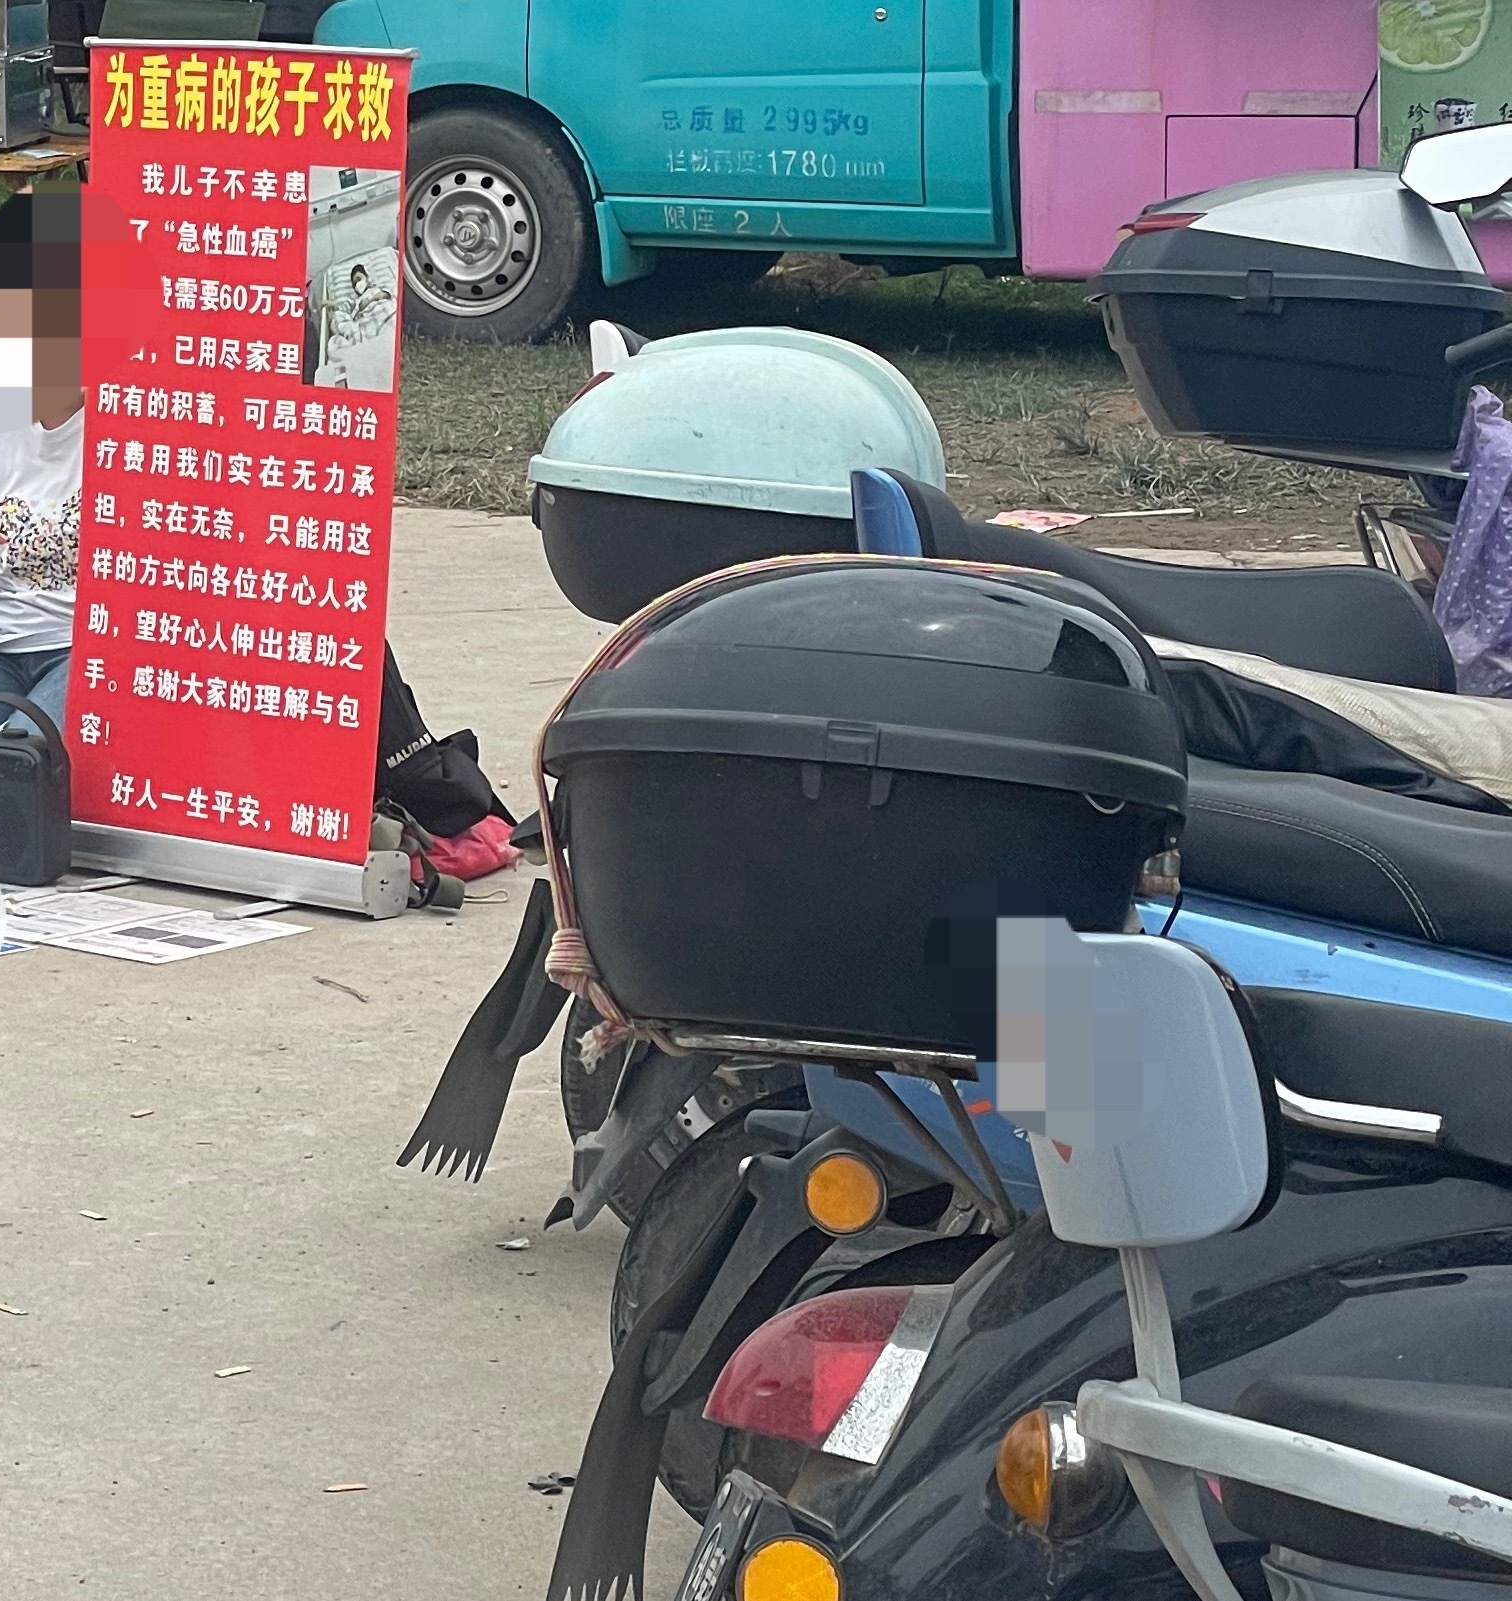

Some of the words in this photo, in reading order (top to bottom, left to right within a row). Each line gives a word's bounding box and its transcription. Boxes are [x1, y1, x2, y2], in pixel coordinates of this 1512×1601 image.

[103, 52, 394, 142] 为重病的孩子求救
[141, 162, 308, 204] 我儿子不幸患
[97, 381, 379, 441] 所有的积蓄，可昂贵的治
[95, 437, 375, 498] 疗费用我们实在无力承
[94, 491, 372, 556] 担，实在无奈，只能用这
[91, 548, 368, 613] 样的方式向各位好心人求
[87, 603, 364, 671] 助，望好心人伸出援助之
[84, 658, 360, 728] 手。感谢大家的理解与包
[111, 772, 349, 842] 好人一生平安，谢谢！
